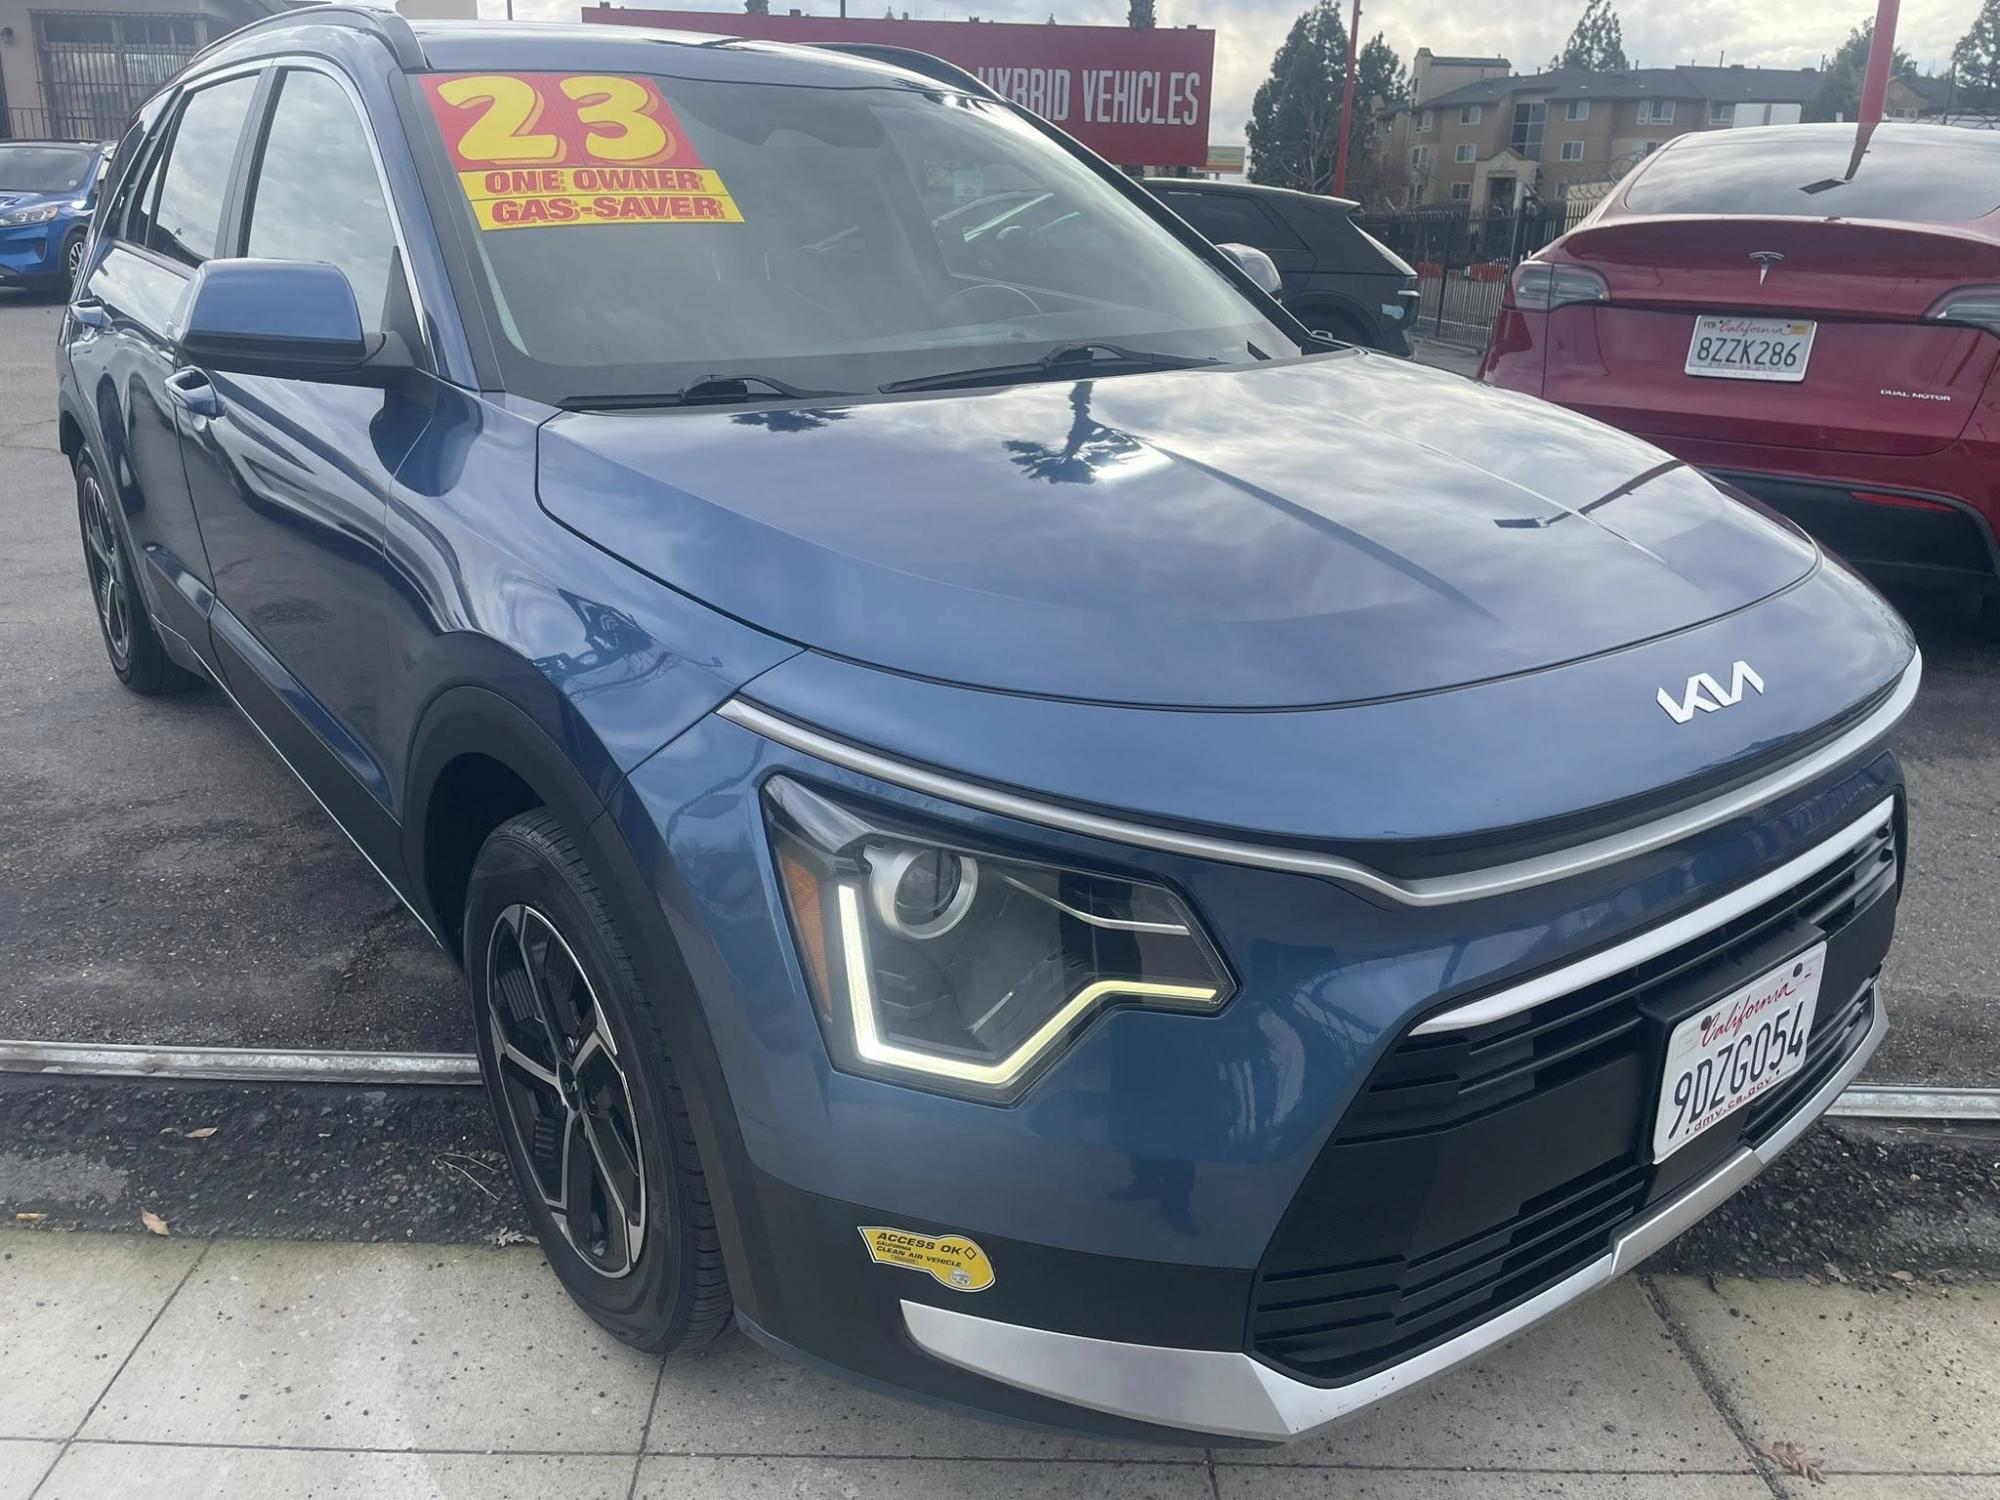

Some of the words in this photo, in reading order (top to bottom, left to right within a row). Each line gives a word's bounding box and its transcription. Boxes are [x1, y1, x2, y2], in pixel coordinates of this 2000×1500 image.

[1082, 70, 1201, 126] VEHICLES
[437, 75, 678, 164] 23
[484, 171, 566, 194] ONE
[572, 169, 706, 192] OWNER
[491, 197, 726, 224] GAS-SAVER
[1720, 319, 1790, 337] California
[1697, 336, 1801, 367] 8ZZK286
[1880, 389, 1910, 398] DUAL
[1912, 392, 1951, 401] MOTOR
[1656, 660, 1764, 725] KIA
[1701, 979, 1796, 1049] California
[1668, 1001, 1804, 1140] 9DZG054
[876, 1245, 906, 1257] CLEAN
[908, 1252, 924, 1260] AIR
[926, 1255, 962, 1268] VEHICLE
[877, 1232, 936, 1250] ACCESS
[940, 1244, 963, 1256] OK
